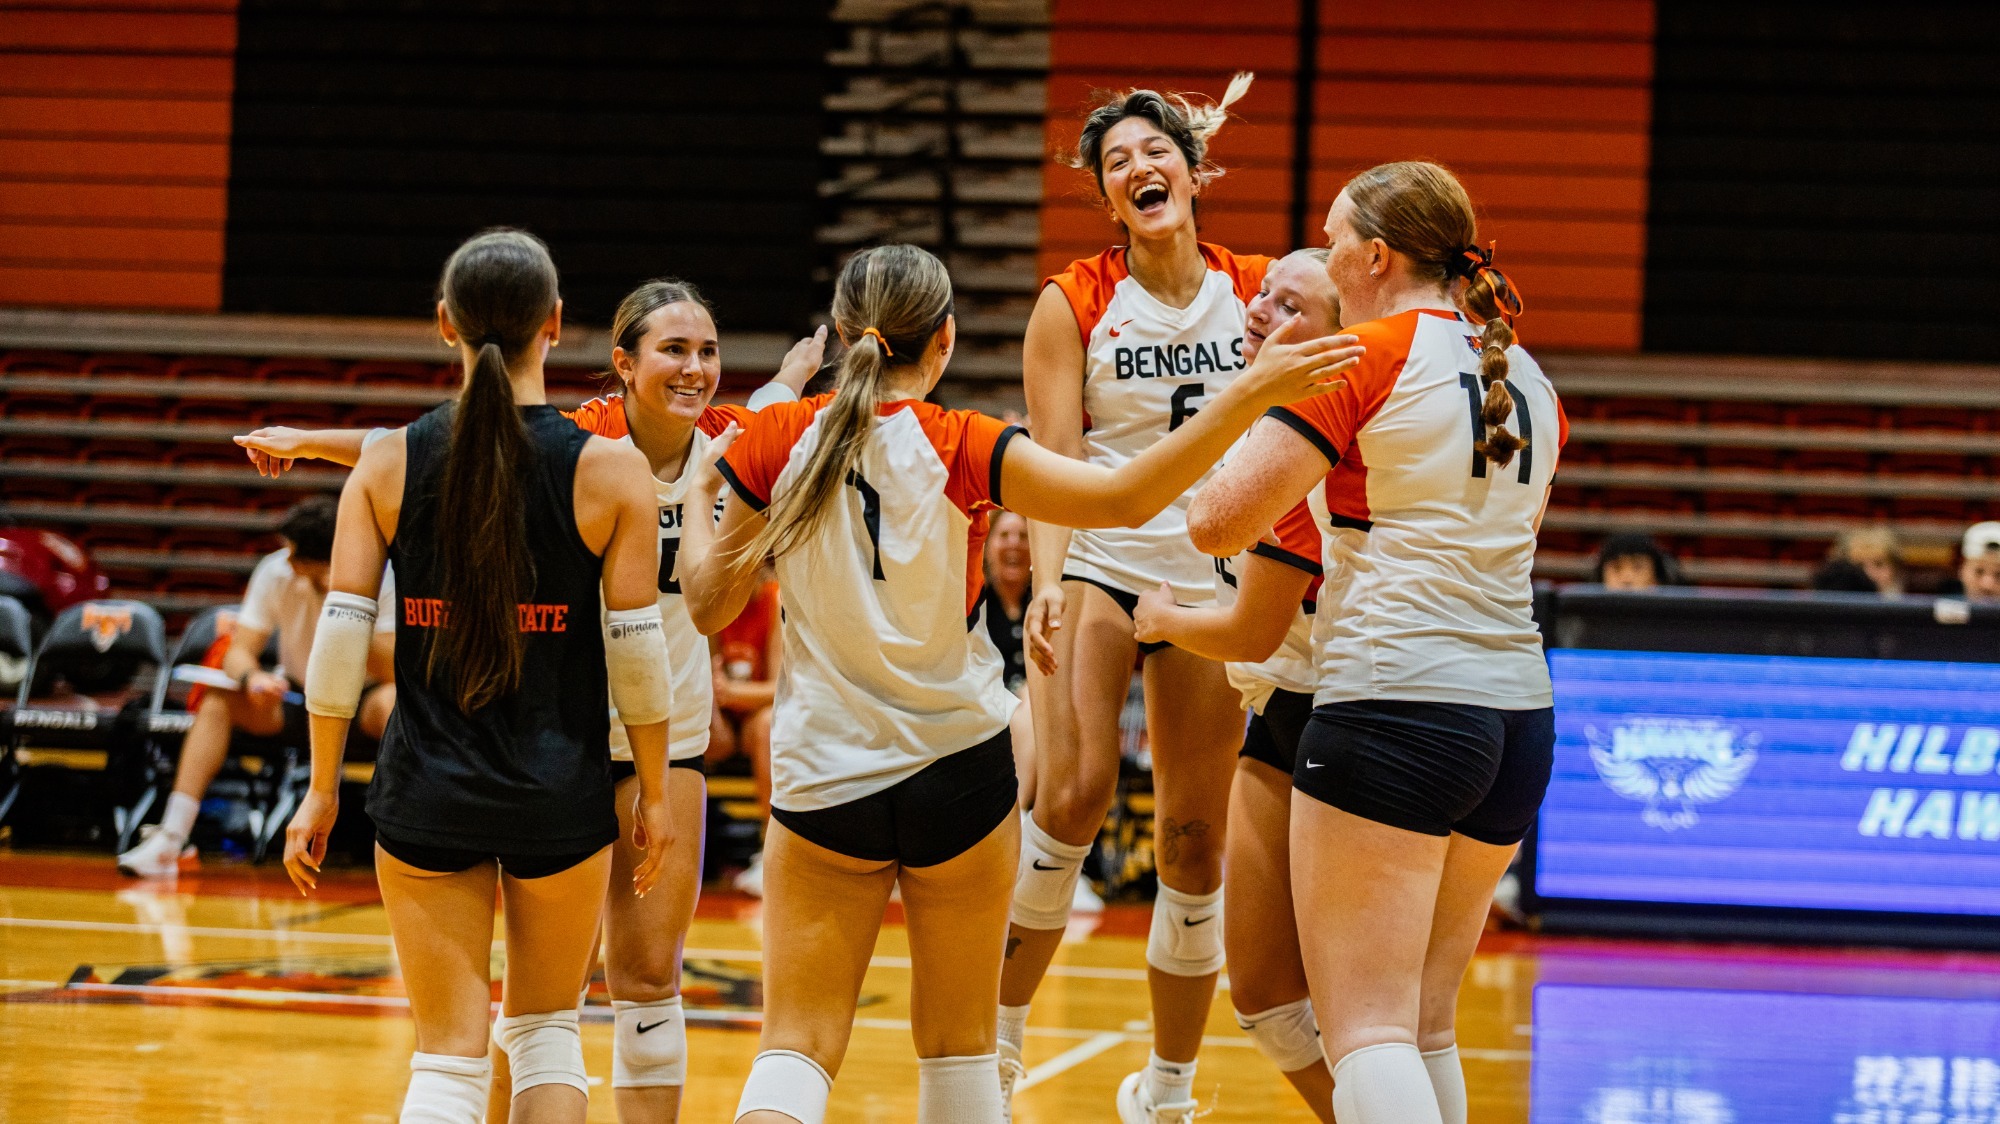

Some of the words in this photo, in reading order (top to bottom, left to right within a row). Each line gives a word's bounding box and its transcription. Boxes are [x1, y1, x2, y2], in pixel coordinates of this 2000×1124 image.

[1115, 337, 1247, 380] BENGALS
[516, 603, 569, 633] TATE
[13, 709, 98, 730] BENGALS
[1840, 722, 2000, 775] HILB
